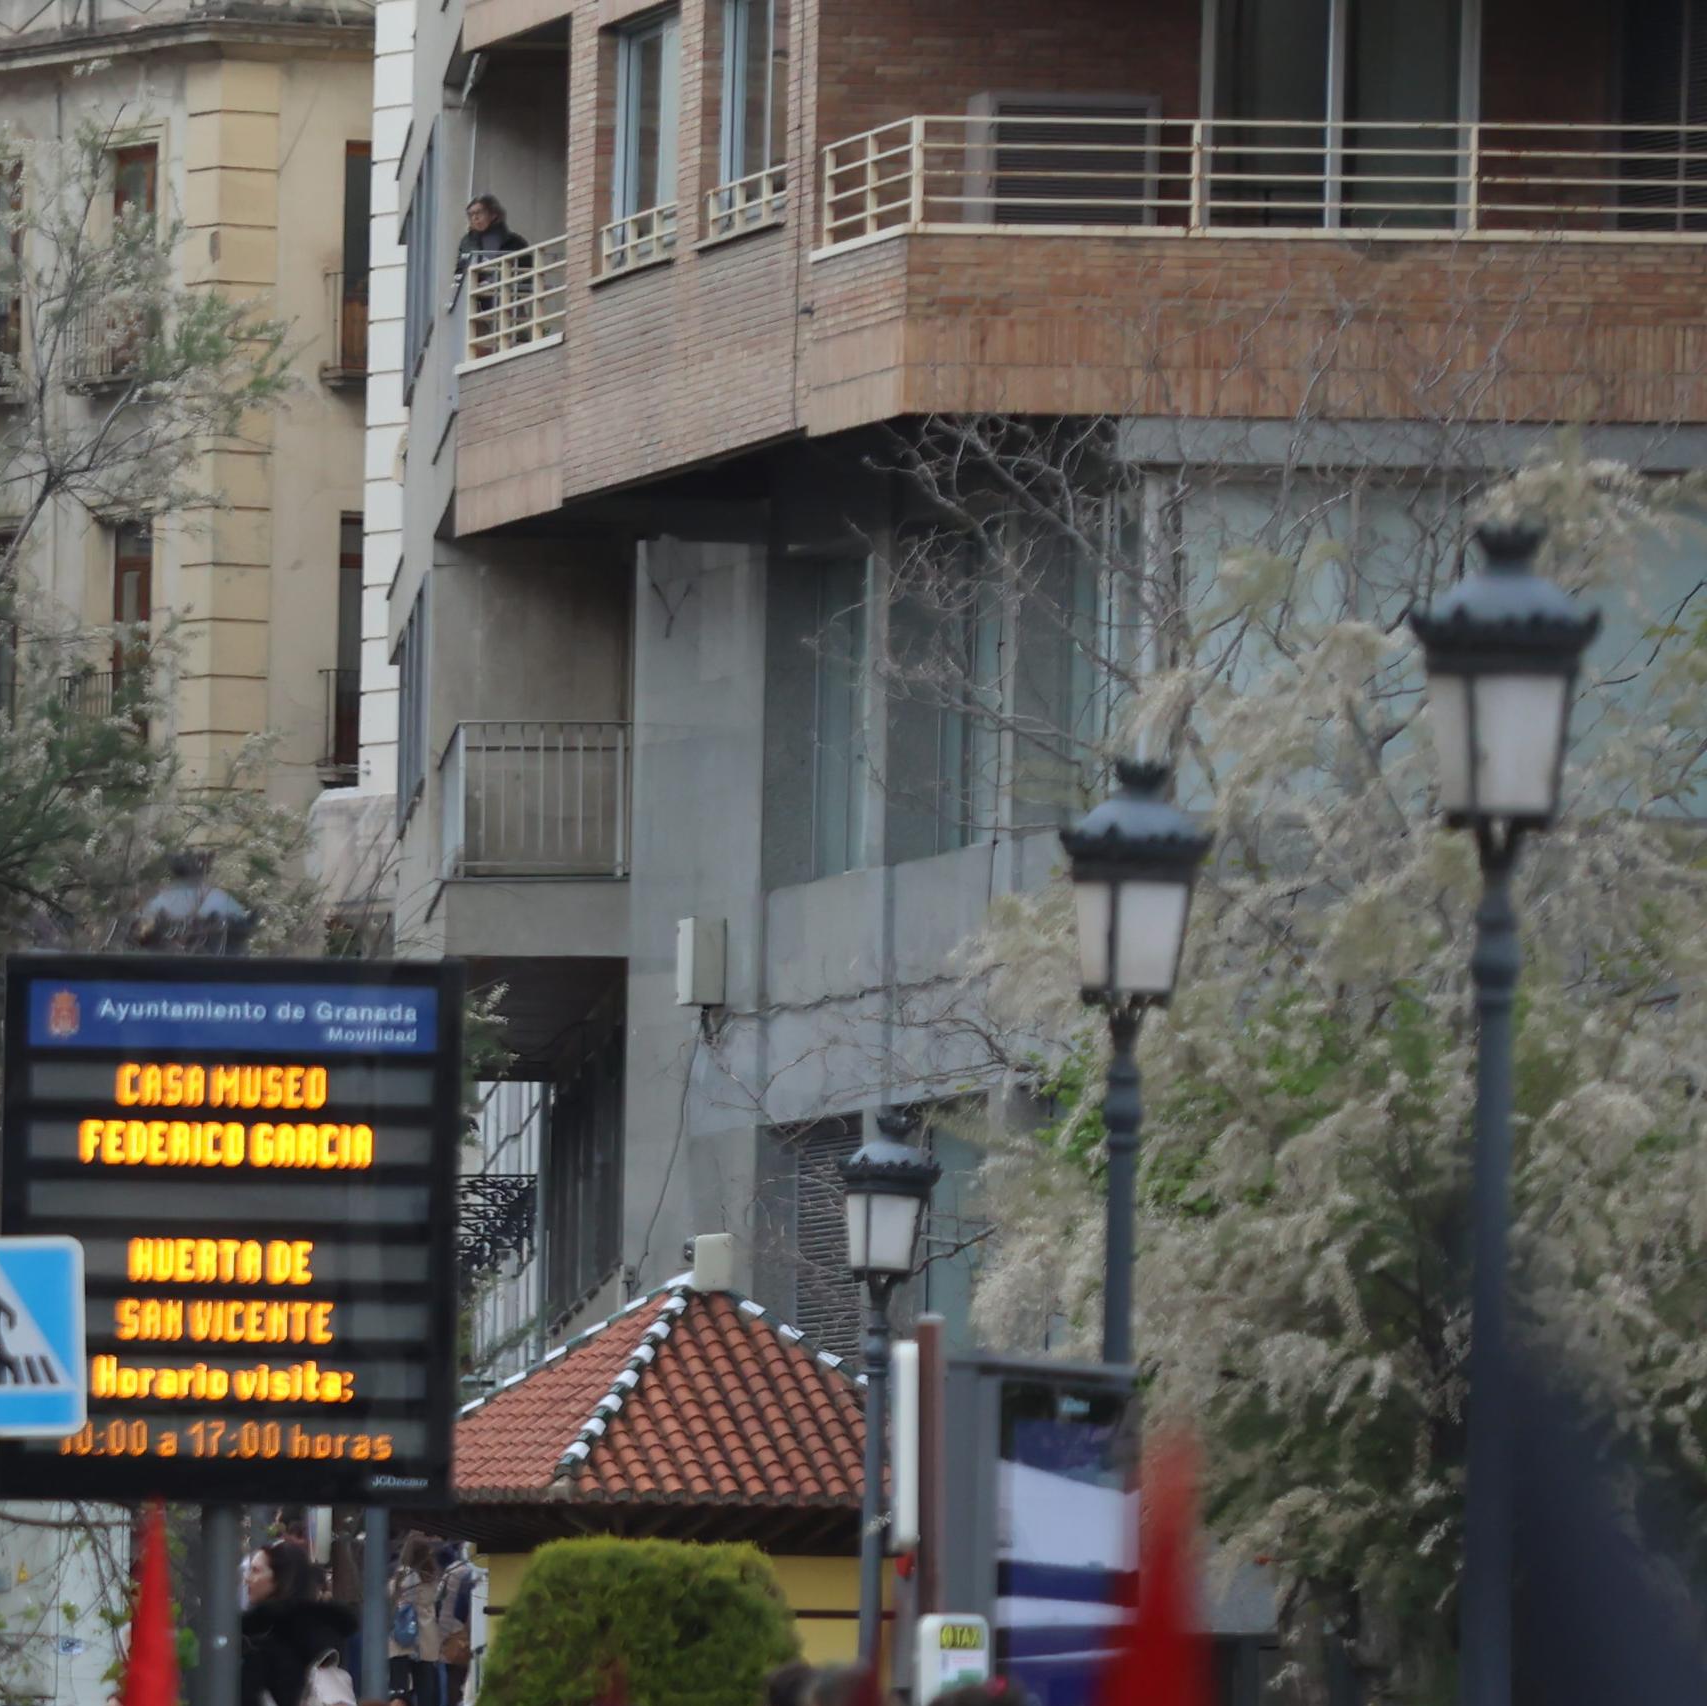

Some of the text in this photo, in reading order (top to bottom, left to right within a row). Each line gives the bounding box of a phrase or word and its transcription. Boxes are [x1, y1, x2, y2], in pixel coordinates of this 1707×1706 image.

[100, 998, 418, 1023] Ayuntamiento de Granada
[327, 1027, 418, 1043] Movilidad
[115, 1062, 328, 1110] CASA MUSEO
[78, 1119, 373, 1169] FEDERICO GARCIA
[127, 1237, 314, 1285] HUERTA DE
[115, 1298, 334, 1345] SAN VICENTE
[91, 1354, 355, 1403] Horario visita:
[155, 1430, 179, 1458] a
[187, 1420, 281, 1460] 17:00
[289, 1423, 394, 1462] horas
